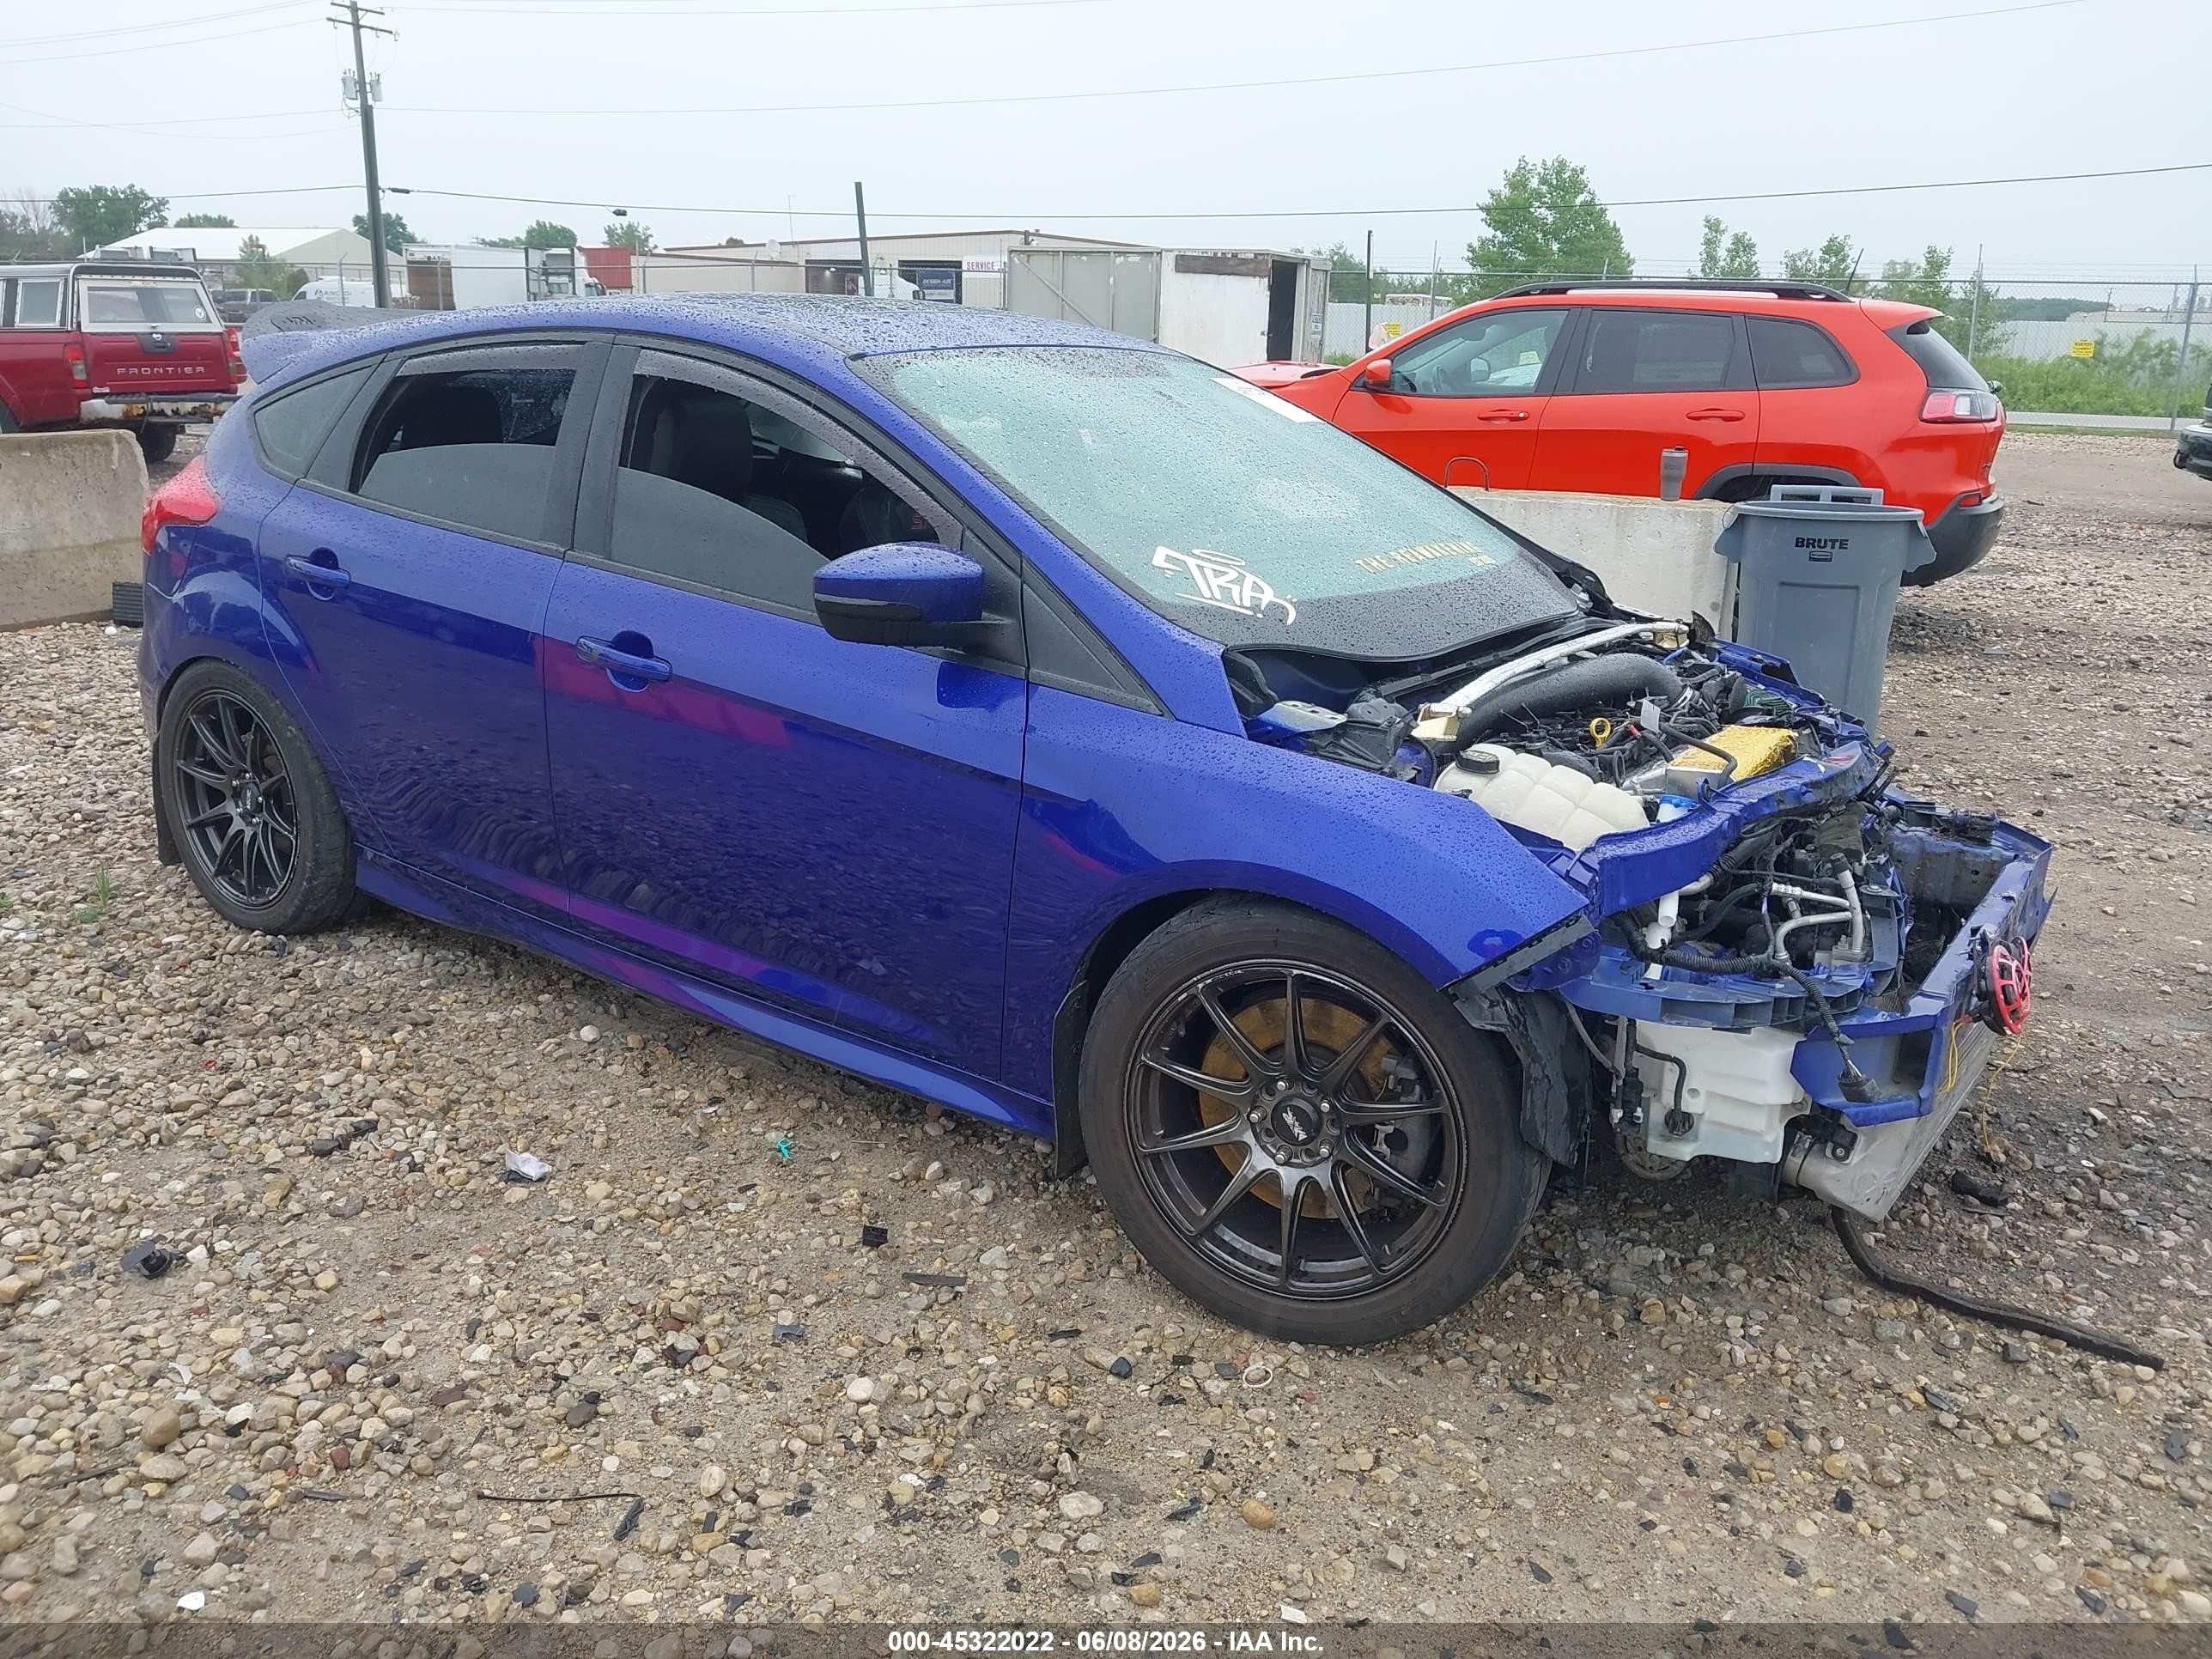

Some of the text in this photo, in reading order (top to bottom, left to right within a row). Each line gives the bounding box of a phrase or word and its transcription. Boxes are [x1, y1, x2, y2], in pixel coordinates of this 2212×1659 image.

[966, 261, 995, 270] SERVICE
[116, 367, 205, 375] FRONTIER
[1795, 537, 1849, 550] BRUTE
[1354, 556, 1395, 575] THE
